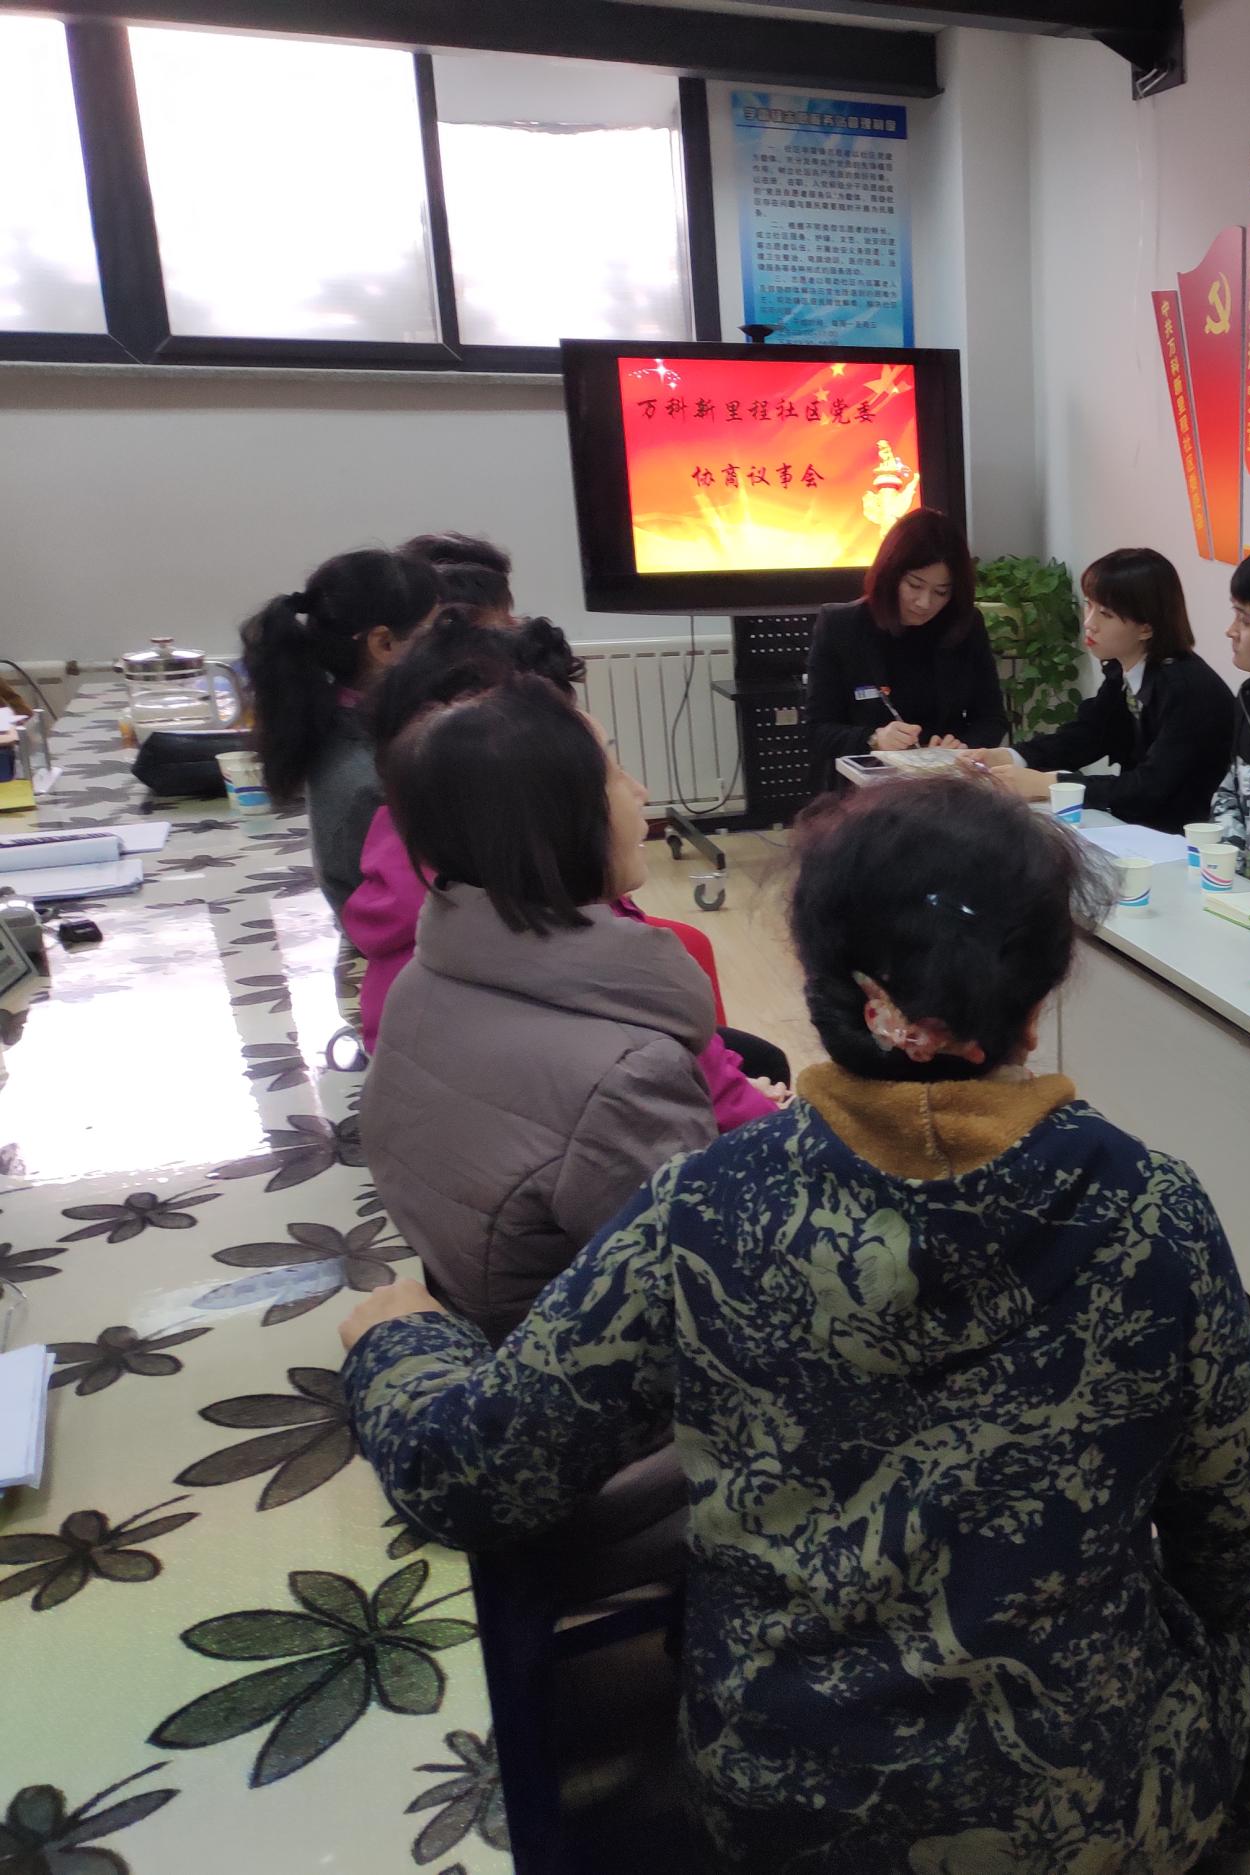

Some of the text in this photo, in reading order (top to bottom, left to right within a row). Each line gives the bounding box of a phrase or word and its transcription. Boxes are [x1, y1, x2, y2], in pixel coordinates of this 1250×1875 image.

[636, 395, 877, 425] 万科新里程社区党委
[690, 462, 826, 490] 协商议事会
